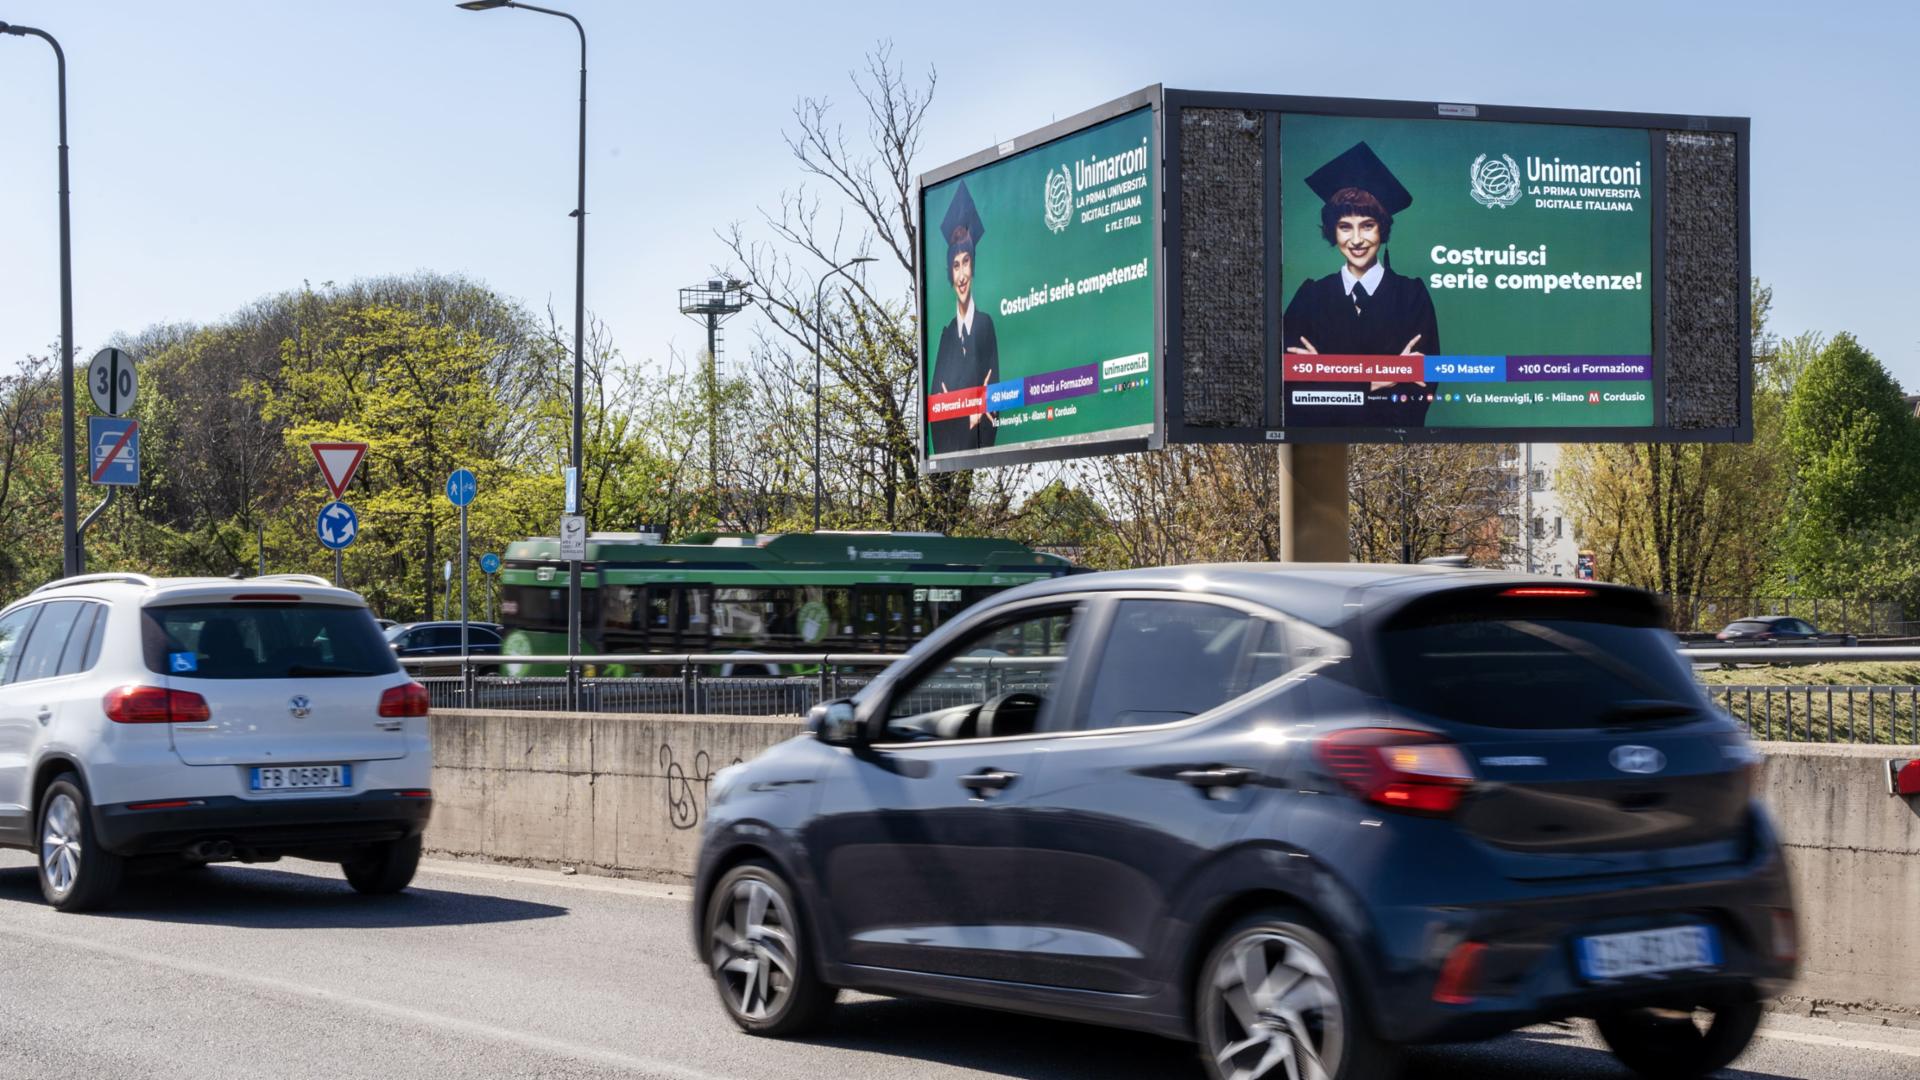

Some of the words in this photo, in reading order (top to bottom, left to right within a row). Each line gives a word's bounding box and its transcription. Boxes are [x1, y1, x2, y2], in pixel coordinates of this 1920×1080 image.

[1076, 137, 1147, 191] Unimarconi
[1527, 156, 1641, 185] Unimarconi
[1076, 197, 1085, 209] LA
[1086, 189, 1106, 206] PRIMA
[1107, 173, 1147, 198] UNIVERSITÀ
[1528, 186, 1540, 195] LA
[1543, 187, 1576, 197] PRIMA
[1579, 188, 1641, 199] UNIVERSITÀ
[1081, 205, 1110, 223] DIGITALE
[1110, 195, 1142, 215] ITALIANA
[1535, 199, 1583, 210] DIGITALE
[1585, 201, 1634, 212] ITALIANA
[1430, 244, 1547, 266] Costruisci
[1000, 284, 1048, 316] Costruisci
[1050, 278, 1075, 302] serie
[1077, 257, 1148, 293] competenze!
[1430, 267, 1489, 289] serie
[1495, 272, 1643, 294] competenze!
[1104, 357, 1147, 376] unimarconi.it
[1292, 363, 1313, 374] +50
[1315, 363, 1363, 374] Percorsi
[1375, 364, 1412, 374] Laurea
[1434, 364, 1455, 374] +50
[1457, 364, 1495, 374] Master
[1518, 364, 1541, 374] +100
[1543, 363, 1571, 374] Corsi
[1573, 366, 1580, 374] di
[1582, 363, 1645, 374] Formazione
[97, 366, 131, 398] 30
[1040, 380, 1055, 394] Corsi
[1060, 376, 1093, 391] Formazione
[1001, 389, 1019, 401] Master
[1294, 394, 1362, 405] unimarconi.it
[1466, 394, 1482, 403] Via
[1484, 393, 1533, 405] Meravigli,
[1552, 393, 1584, 402] Milano
[1603, 392, 1645, 402] Cordusio
[262, 768, 284, 788] FB
